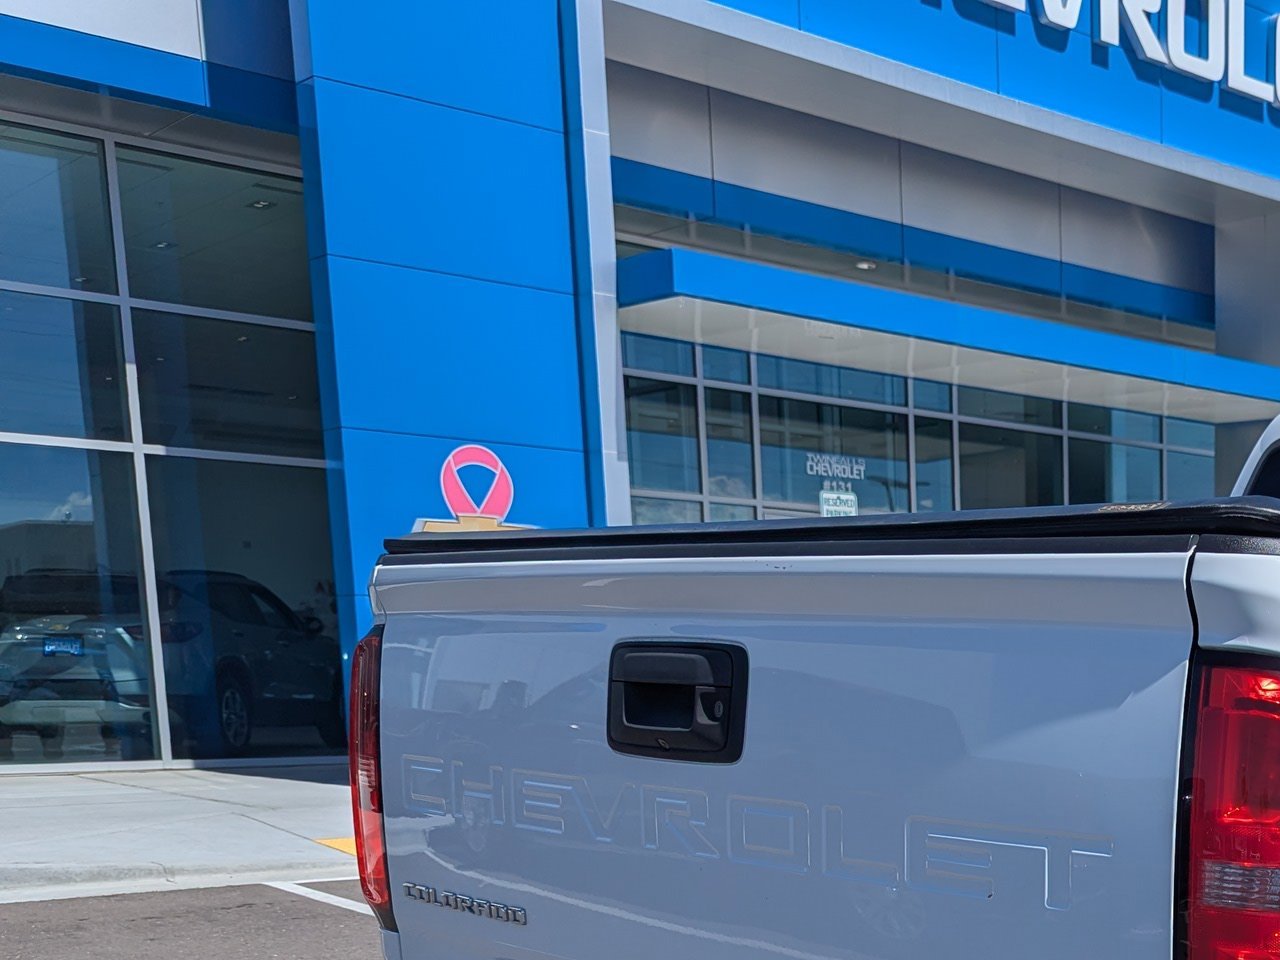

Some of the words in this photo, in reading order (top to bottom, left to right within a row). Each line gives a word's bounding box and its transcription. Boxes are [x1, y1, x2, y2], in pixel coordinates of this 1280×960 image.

[806, 461, 865, 480] CHEVROLET
[401, 753, 1116, 912] CHEVROLET
[402, 881, 528, 926] COLORADO
